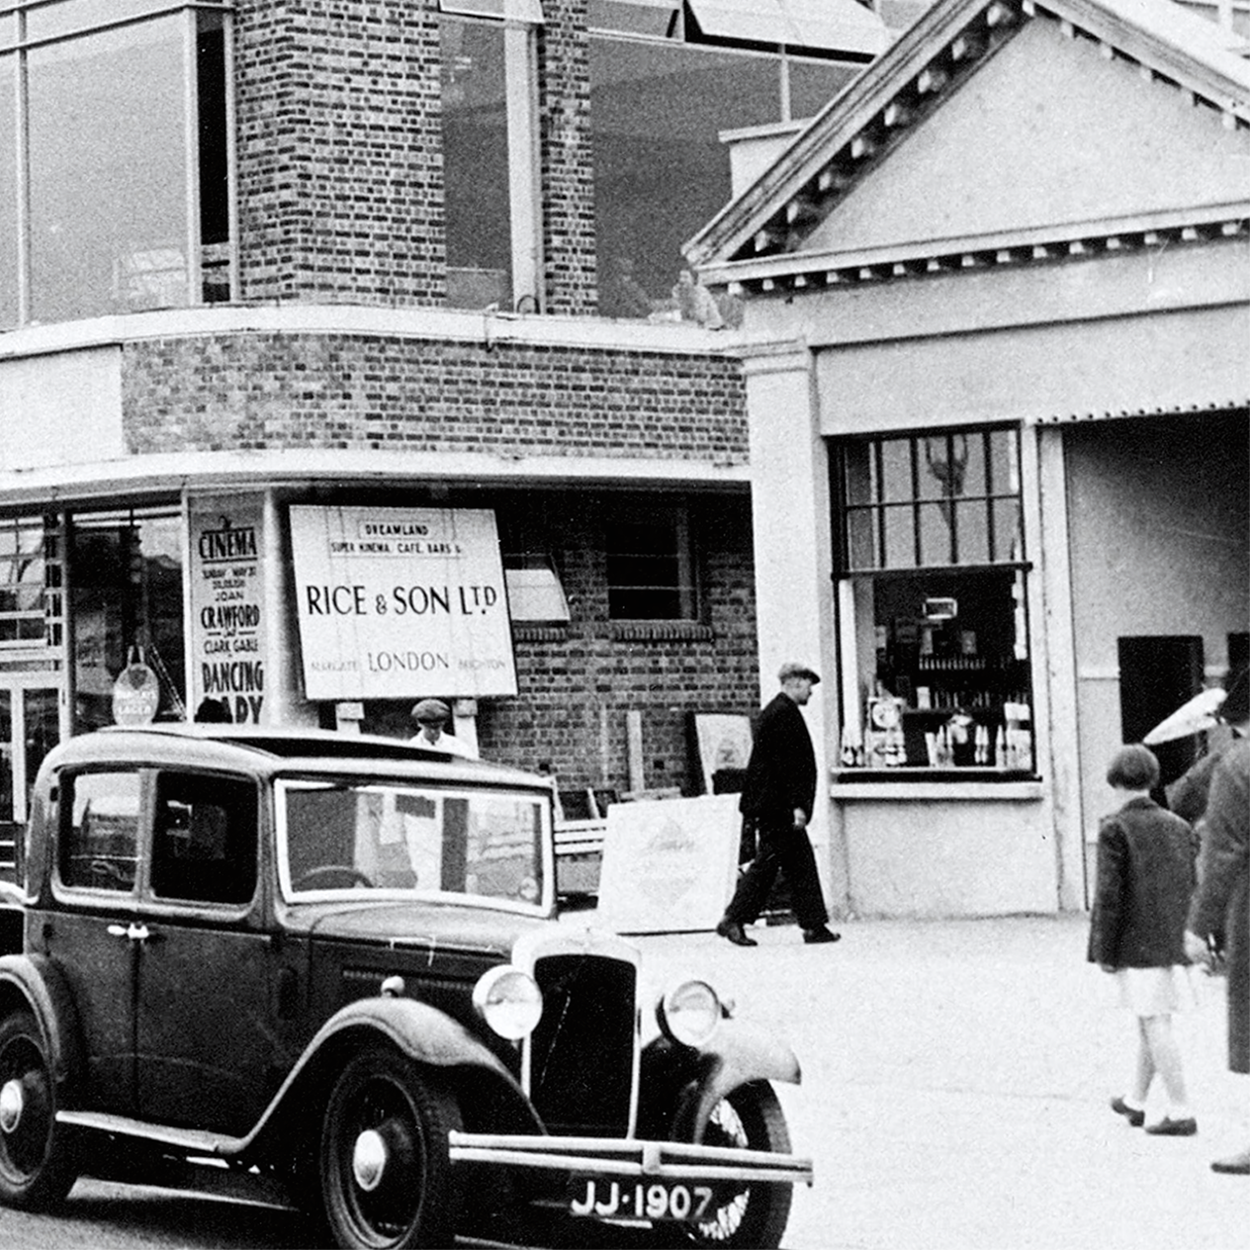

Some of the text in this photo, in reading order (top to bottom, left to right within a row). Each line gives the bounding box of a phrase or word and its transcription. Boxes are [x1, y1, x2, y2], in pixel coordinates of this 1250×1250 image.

[365, 524, 429, 536] DREAMLAND
[198, 530, 258, 559] CINEMA
[214, 591, 244, 602] JOAN
[306, 585, 368, 616] RICE
[375, 594, 388, 616] &
[393, 585, 451, 616] SON
[200, 604, 261, 629] CRAWFORD
[203, 638, 259, 654] CLARK GABLE
[367, 651, 450, 673] LONDON
[202, 661, 264, 693] DANCING
